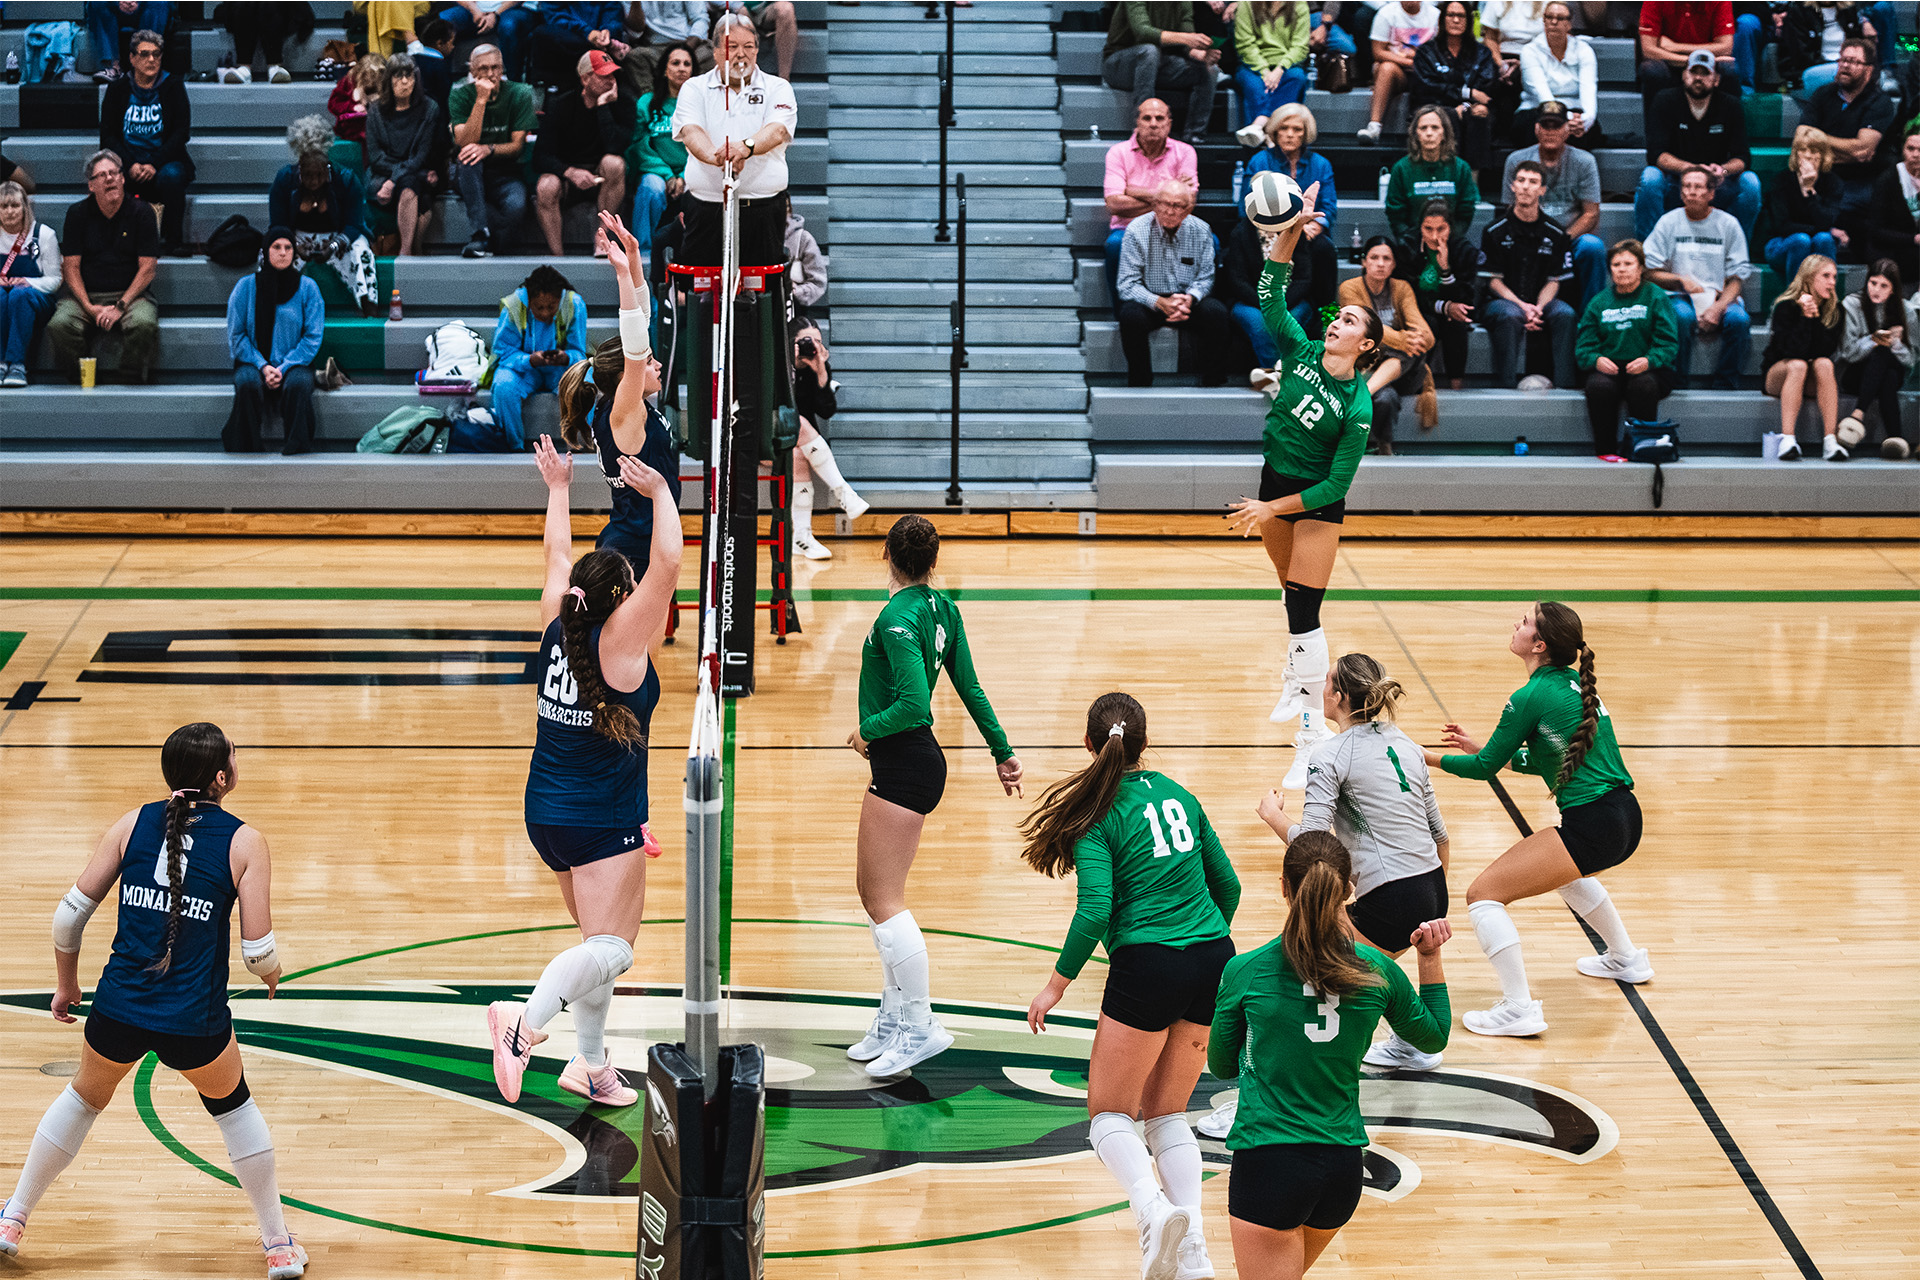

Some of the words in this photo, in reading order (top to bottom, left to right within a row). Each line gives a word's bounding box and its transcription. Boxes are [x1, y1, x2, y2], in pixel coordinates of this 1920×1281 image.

[124, 103, 162, 122] MERC
[1291, 394, 1324, 430] 12
[543, 644, 578, 705] 20
[1386, 745, 1412, 793] 1
[1143, 798, 1195, 858] 18
[1303, 982, 1340, 1042] 3
